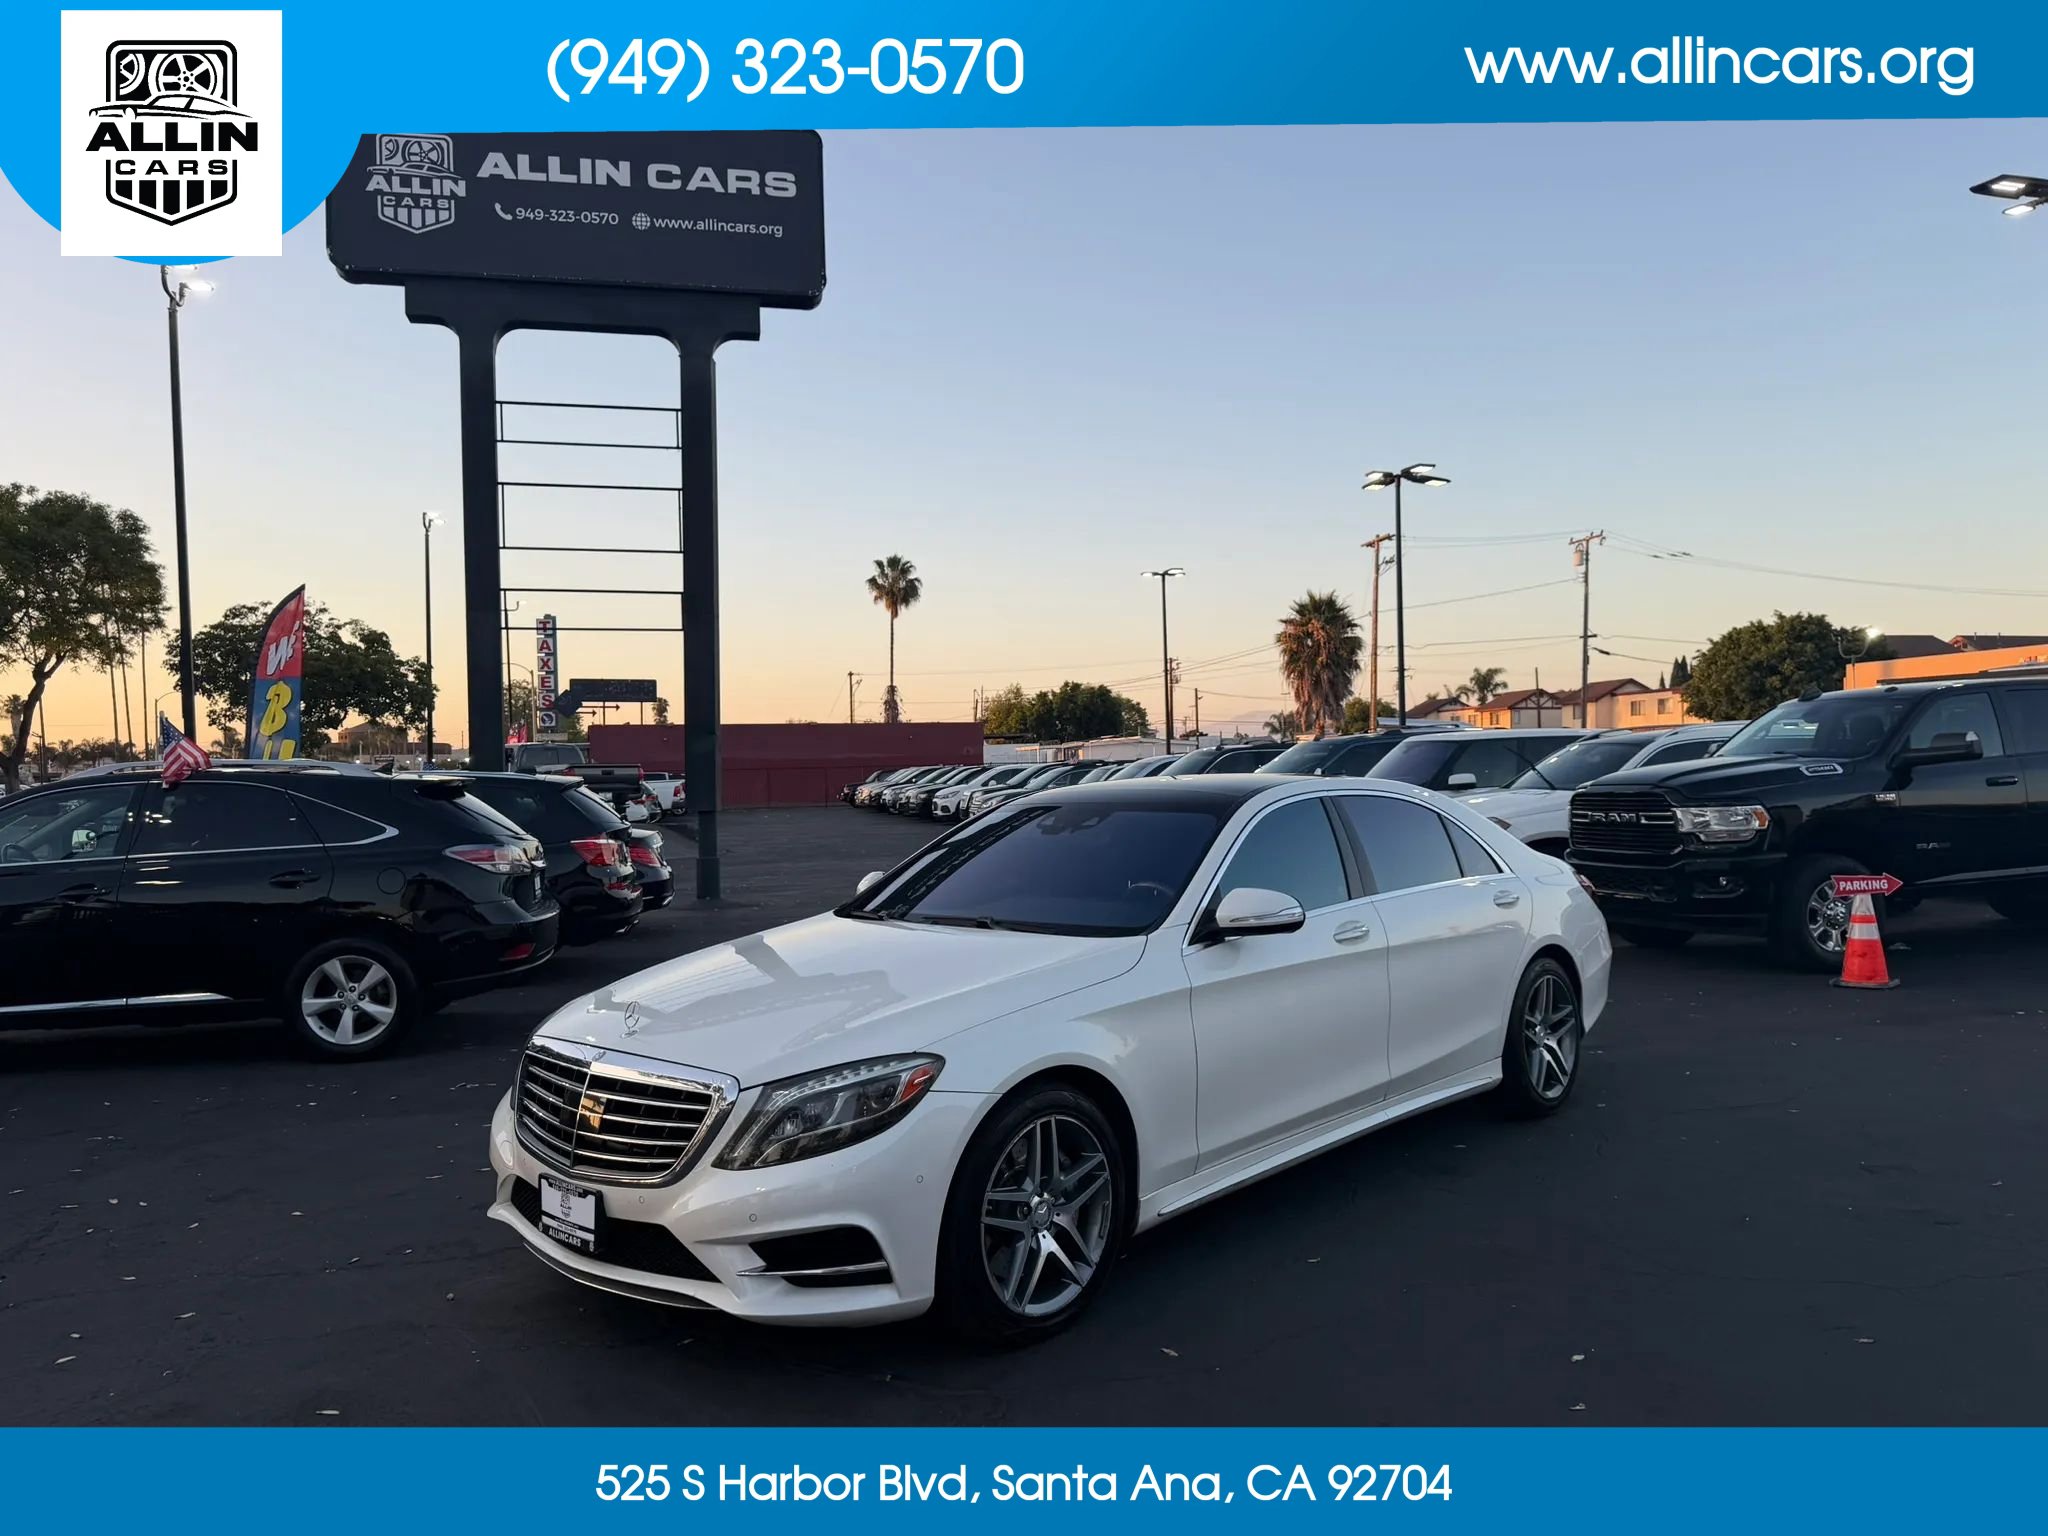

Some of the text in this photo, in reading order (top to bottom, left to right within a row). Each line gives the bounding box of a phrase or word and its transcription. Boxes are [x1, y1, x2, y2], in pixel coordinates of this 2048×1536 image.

[476, 151, 797, 198] ALLIN CARS
[365, 174, 467, 197] ALLIN
[382, 195, 450, 209] CARS
[515, 207, 619, 225] 949-323-0570
[653, 216, 783, 238] www.allincars.org
[538, 620, 554, 709] TAXES
[1590, 812, 1637, 823] RAM
[1839, 879, 1889, 891] PARKING
[548, 1227, 581, 1247] ALLINCARS
